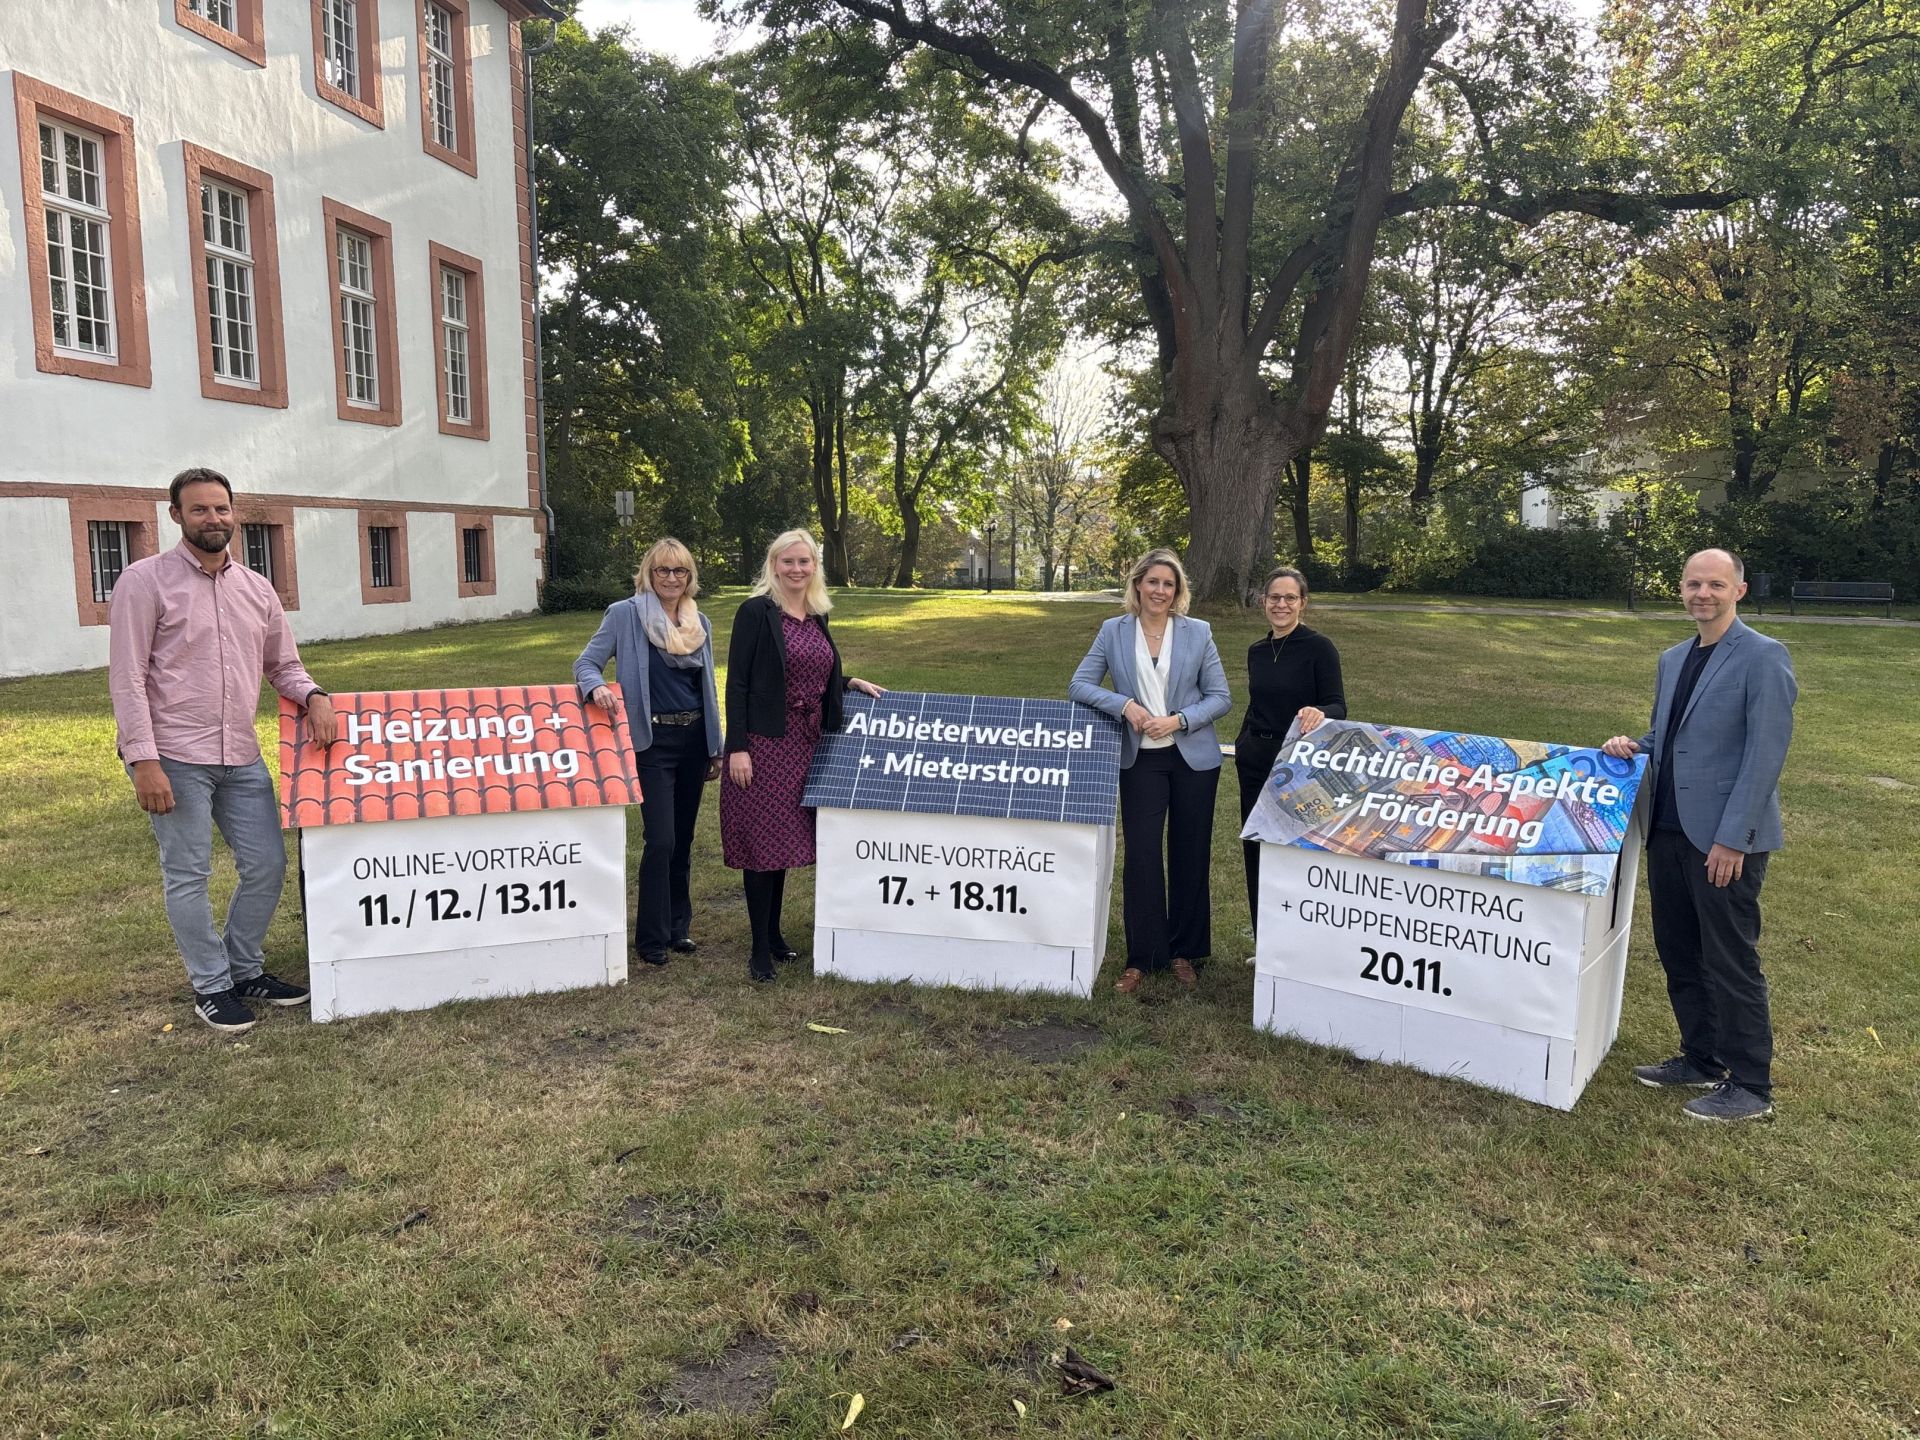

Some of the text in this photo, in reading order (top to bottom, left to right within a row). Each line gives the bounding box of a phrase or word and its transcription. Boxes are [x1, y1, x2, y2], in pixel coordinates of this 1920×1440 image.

[347, 711, 568, 744] Heizung +
[846, 712, 1093, 749] Anbieterwechsel
[344, 748, 579, 785] Sanierung
[859, 752, 1070, 787] + Mieterstrom
[1288, 740, 1619, 806] Rechtliche Aspekte
[1334, 793, 1352, 808] +
[1358, 792, 1544, 848] Förderung
[353, 840, 582, 880] ONLINE-VORTRÄGE
[856, 839, 1056, 874] ONLINE-VORTRÄGE
[878, 875, 1028, 915] 17. + 18.11.
[1307, 865, 1523, 923] ONLINE-VORTRAG
[1281, 899, 1551, 967] + GRUPPENBERATUNG
[1360, 946, 1452, 997] 20.11.
